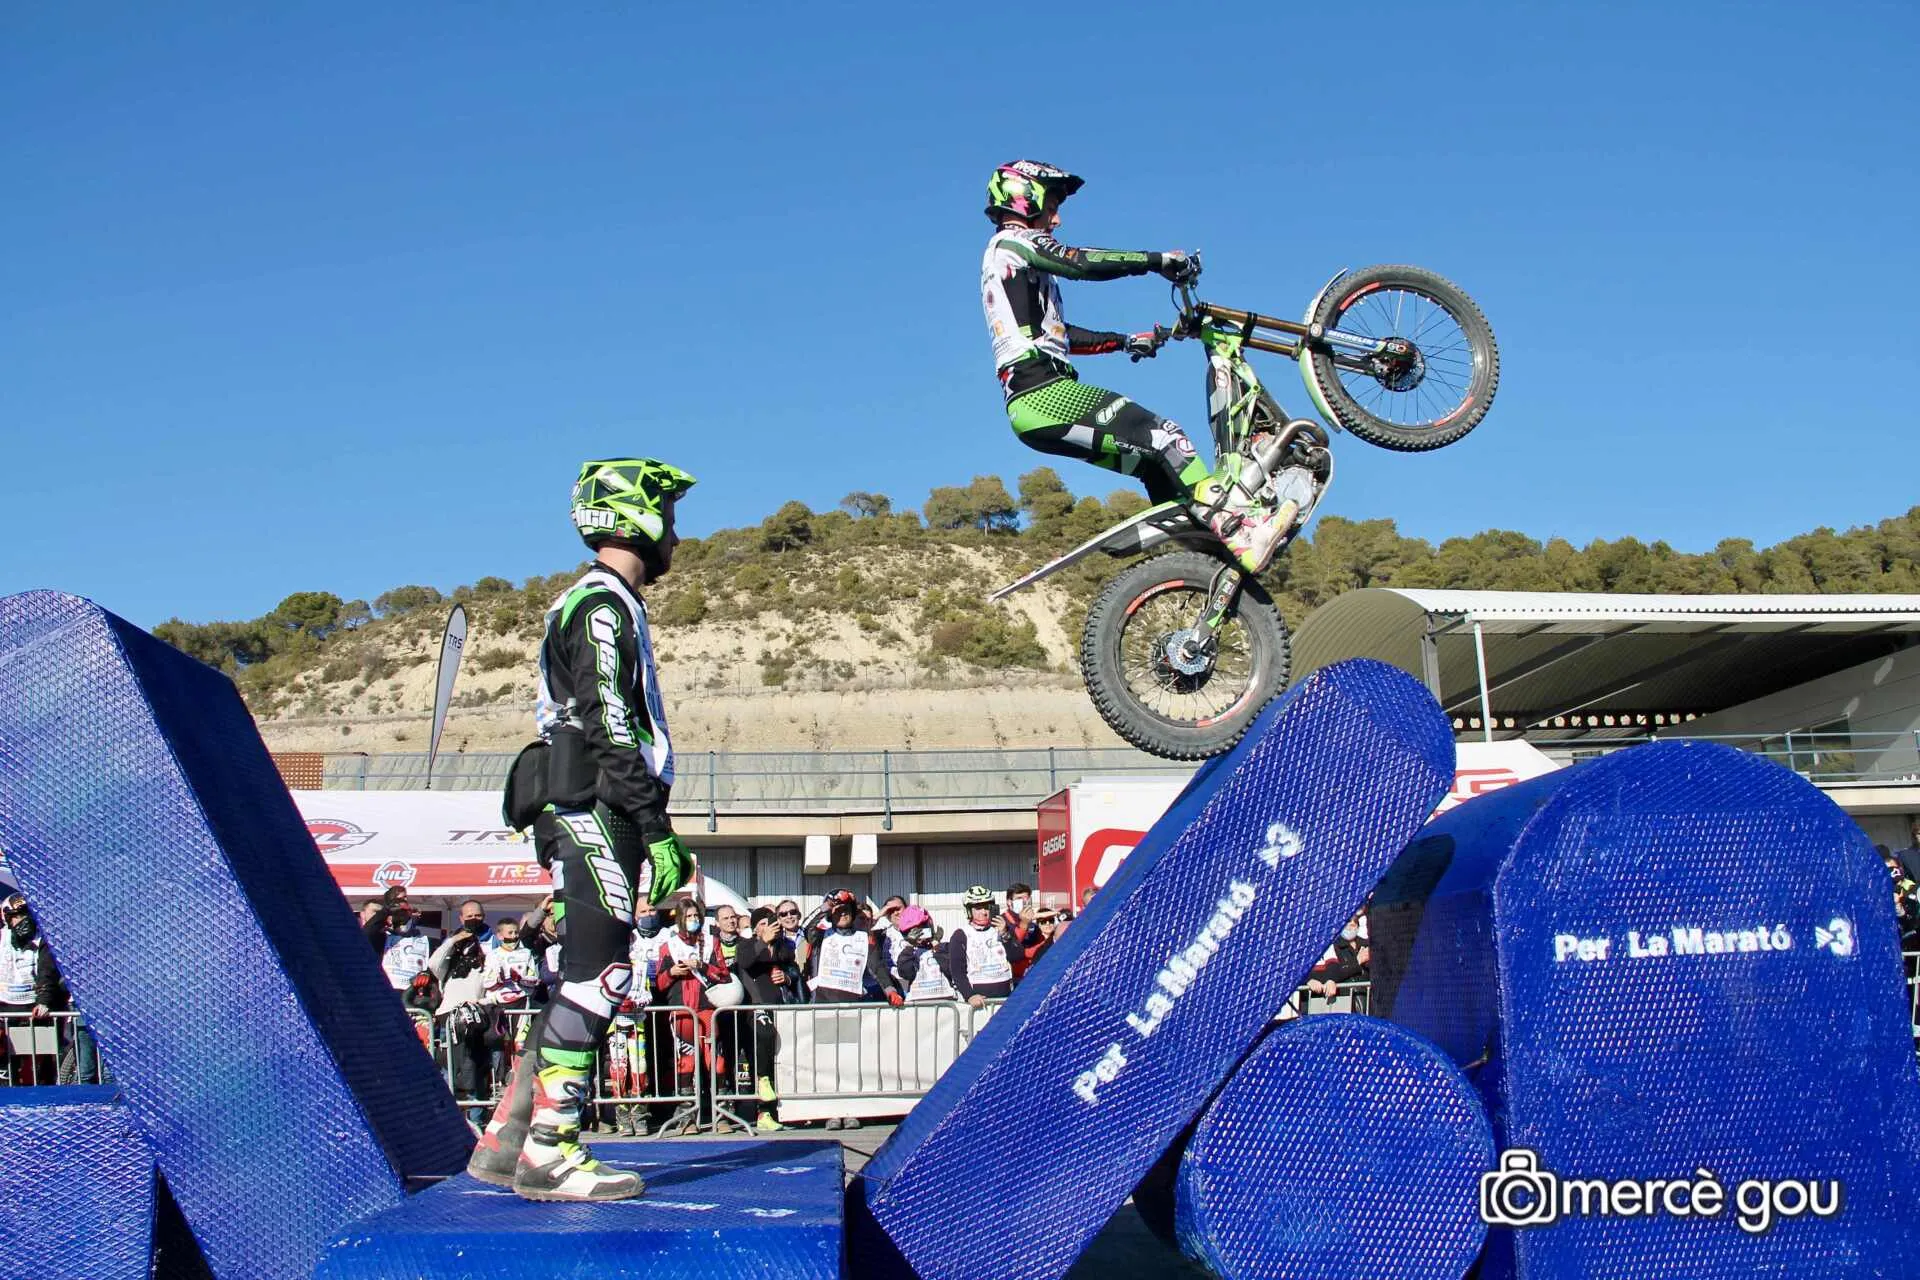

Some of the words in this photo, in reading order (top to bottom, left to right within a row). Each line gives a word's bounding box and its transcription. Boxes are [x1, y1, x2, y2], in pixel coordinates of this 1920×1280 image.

[1042, 832, 1066, 857] GASGAS
[376, 868, 414, 881] NILS
[1554, 933, 1611, 963] Per
[1072, 1042, 1127, 1103] Per
